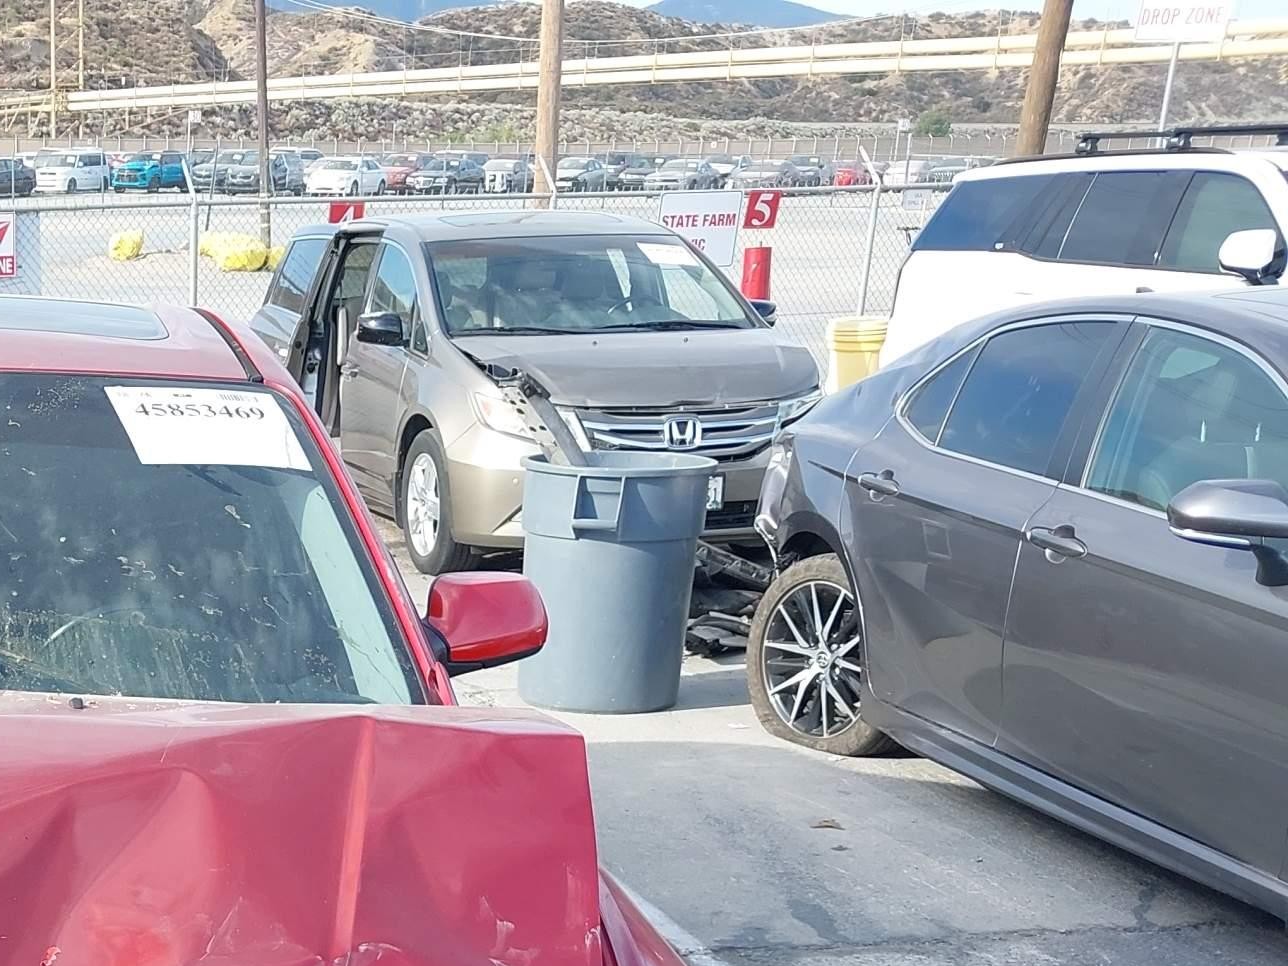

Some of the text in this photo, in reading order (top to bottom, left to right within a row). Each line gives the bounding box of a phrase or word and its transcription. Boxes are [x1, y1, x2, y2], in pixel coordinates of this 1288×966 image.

[1141, 6, 1224, 25] DROP ZONE
[751, 193, 774, 226] 5
[662, 213, 737, 228] STATE FARM
[135, 402, 265, 420] 45853469
